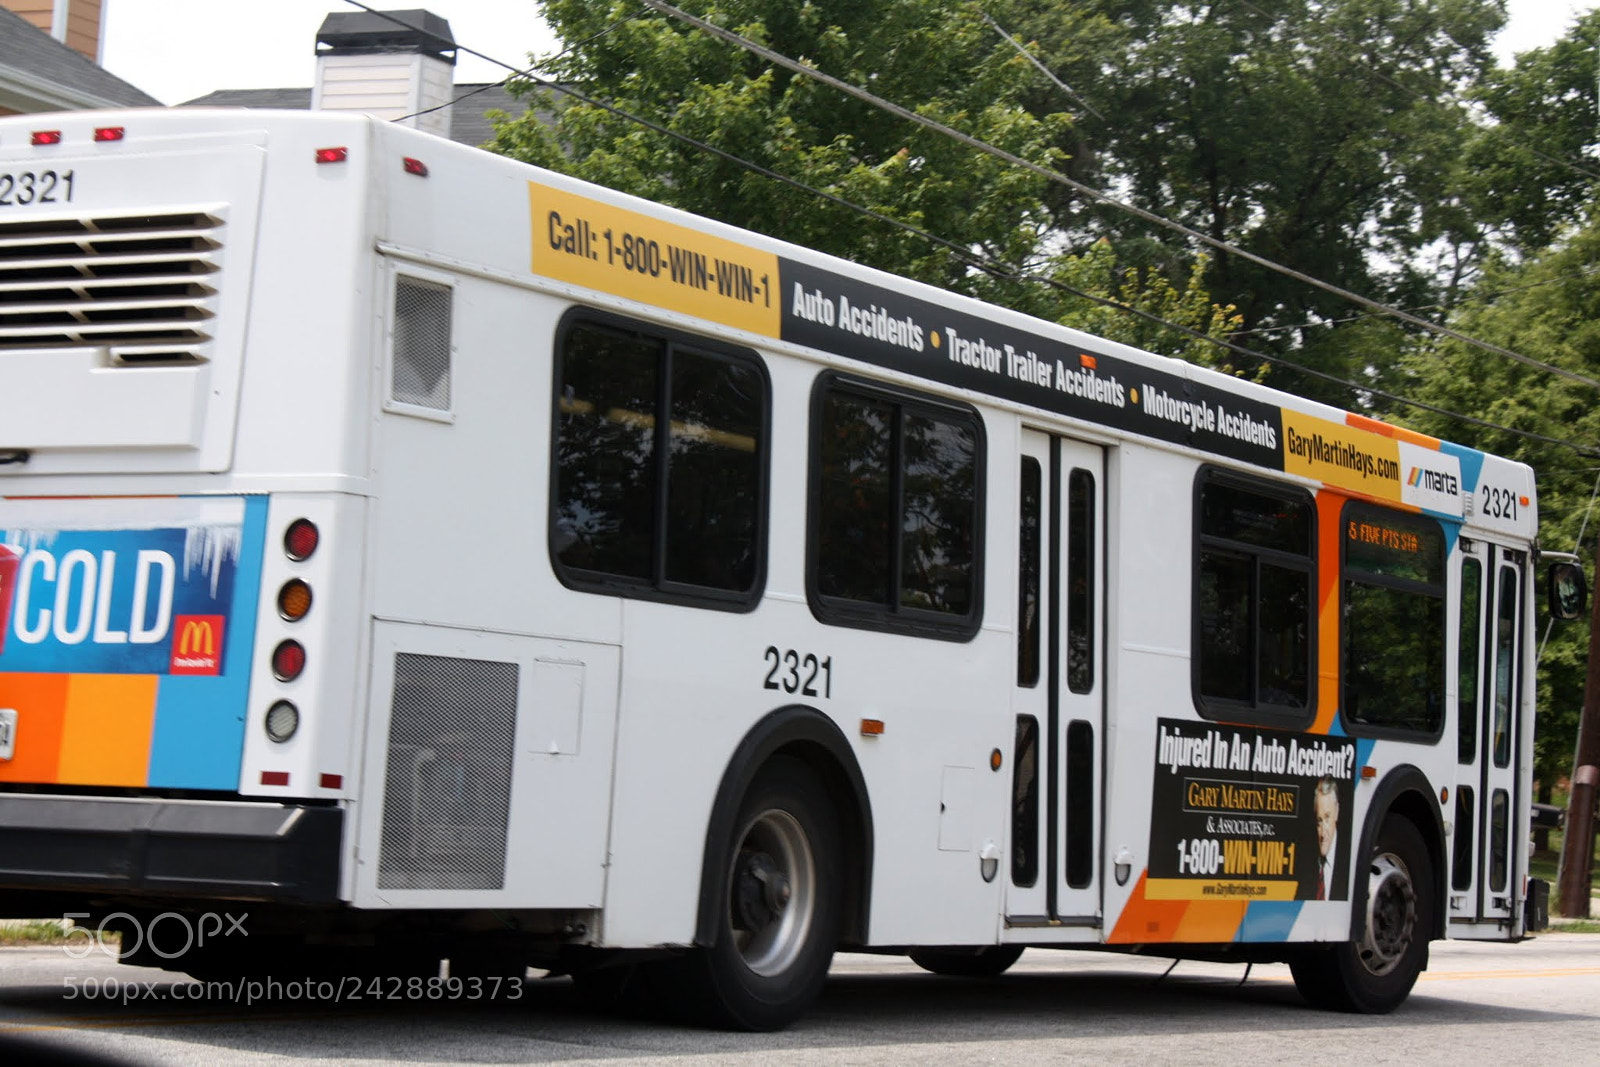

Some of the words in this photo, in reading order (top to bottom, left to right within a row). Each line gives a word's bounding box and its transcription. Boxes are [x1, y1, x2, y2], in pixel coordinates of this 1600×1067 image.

[0, 168, 74, 205] 2321
[548, 210, 598, 261] Call:
[604, 228, 770, 308] 1-800-WIN-WIN-1
[792, 281, 835, 327] Auto
[838, 295, 924, 352] Accidents
[945, 326, 1002, 375] Tractor
[1003, 343, 1053, 389] Trailer
[1055, 359, 1126, 409] Accidents
[1142, 383, 1215, 433] Motorcycle
[1217, 405, 1277, 450] Accidents
[1288, 426, 1399, 481] GaryMartinHays.com
[1424, 469, 1458, 496] marta
[1483, 485, 1517, 521] 2321
[1360, 524, 1380, 545] FIVE
[1382, 528, 1399, 549] PTS
[13, 549, 176, 644] COLD
[763, 645, 832, 699] 2321
[1159, 726, 1213, 775] Injured
[1213, 731, 1228, 769] In
[1229, 732, 1250, 771] An
[1252, 735, 1285, 775] Auto
[1287, 739, 1355, 779] Accident?
[1188, 782, 1219, 808] GARY
[1221, 784, 1265, 810] MARTIN
[1266, 787, 1294, 812] HAYS
[1206, 816, 1216, 833] &
[1177, 838, 1295, 875] 1-800-WIN-WIN-1
